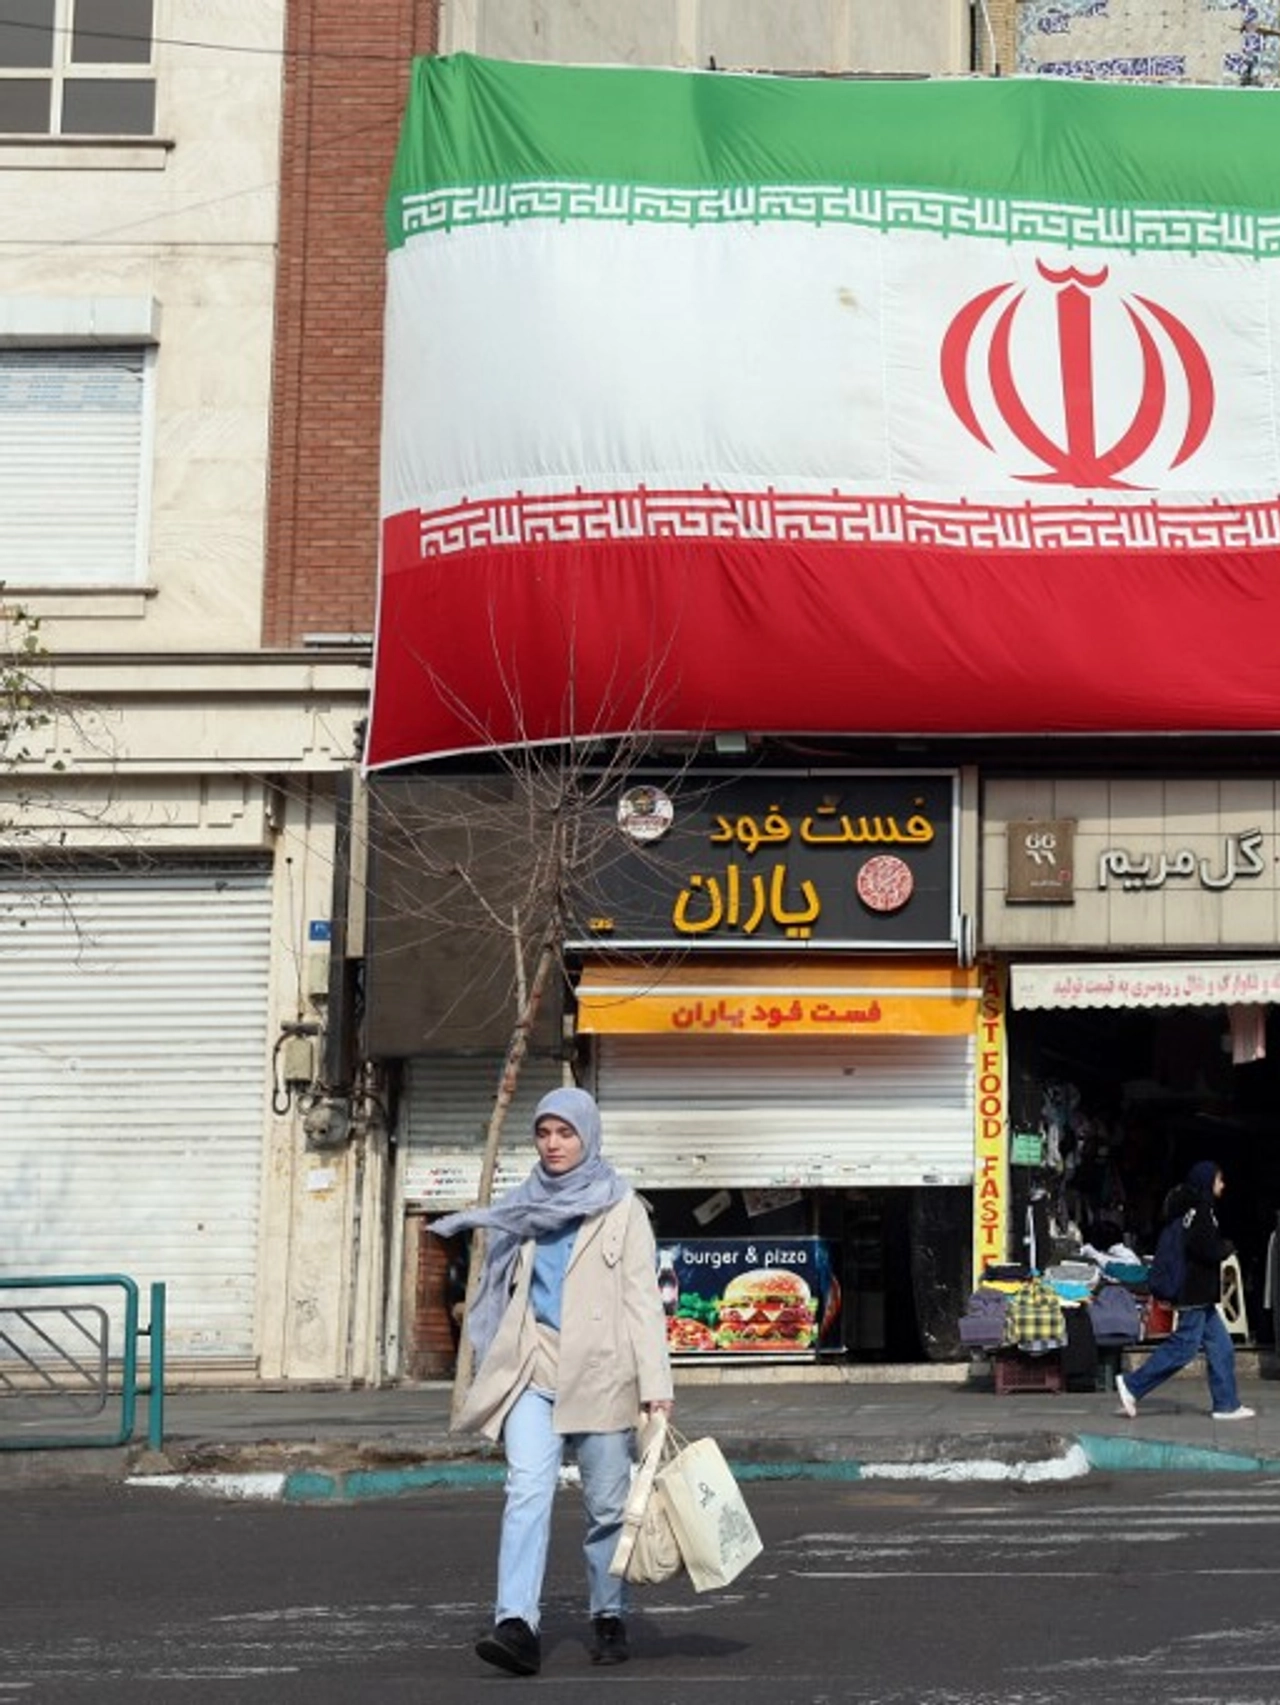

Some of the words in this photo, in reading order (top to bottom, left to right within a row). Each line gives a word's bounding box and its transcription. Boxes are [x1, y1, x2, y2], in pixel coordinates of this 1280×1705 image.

[710, 805, 793, 854] فود
[801, 797, 935, 843] فست
[1097, 849, 1197, 891] مریم
[1199, 828, 1265, 890] گل
[672, 863, 822, 938] یاران
[752, 1001, 803, 1028] فود
[811, 1001, 881, 1023] فست
[979, 1052, 1001, 1139] FOOD
[980, 1156, 999, 1245] FAST
[683, 1248, 739, 1269] burger
[744, 1246, 758, 1264] &
[765, 1248, 807, 1268] pizza
